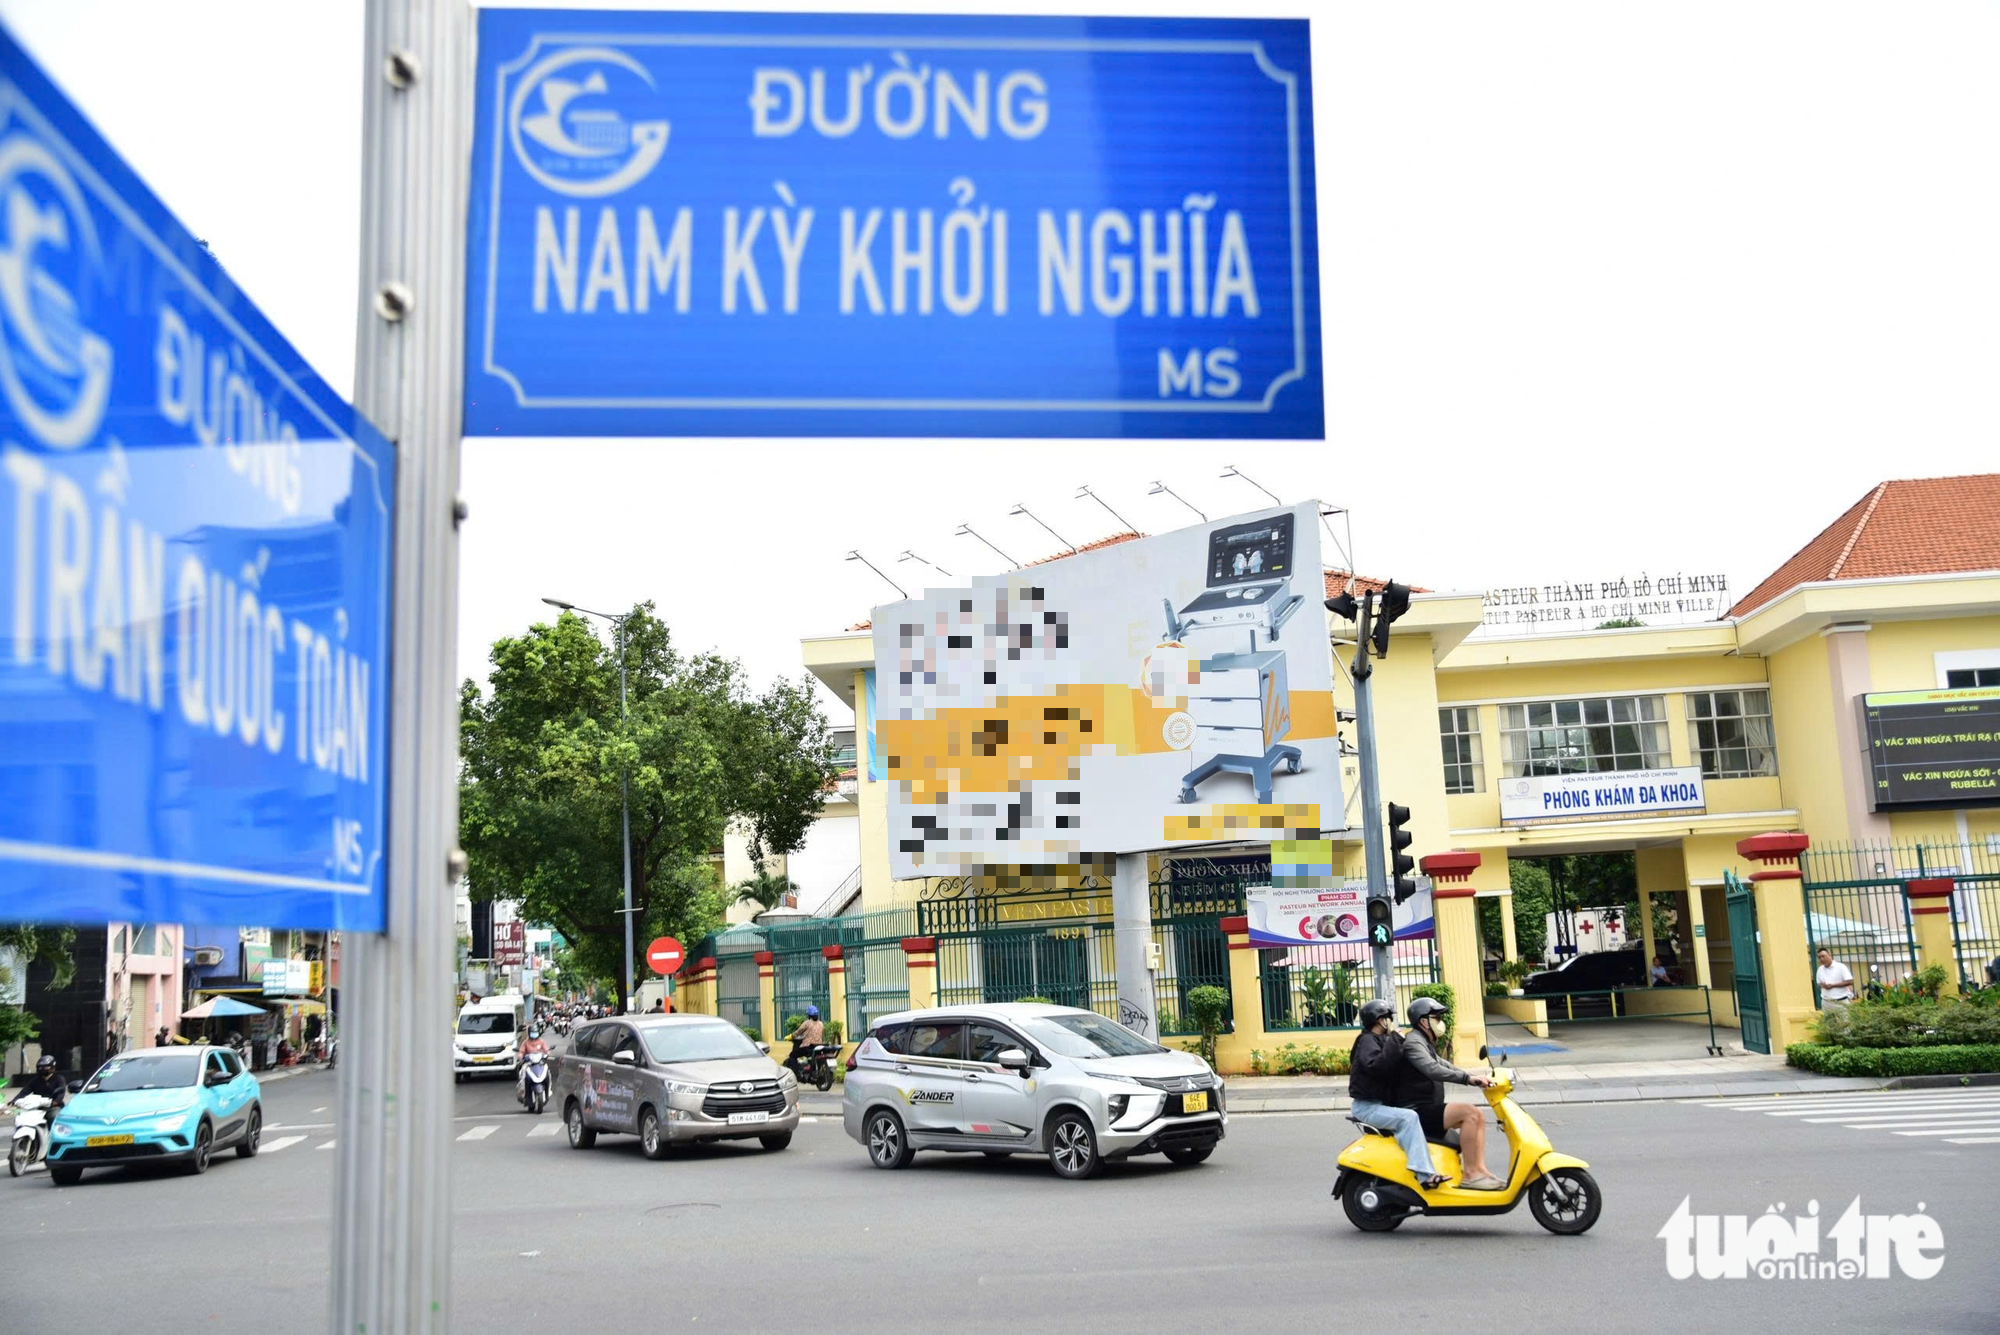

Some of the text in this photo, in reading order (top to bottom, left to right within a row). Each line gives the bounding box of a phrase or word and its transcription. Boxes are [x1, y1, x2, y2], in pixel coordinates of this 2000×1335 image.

[749, 52, 1049, 139] ĐƯỜNG
[533, 178, 1260, 317] NAM KỲ KHỞI NGHĨA
[1158, 348, 1240, 397] MS
[1544, 580, 1594, 603] THÀNH
[1601, 575, 1627, 599] PHỐ
[1633, 571, 1651, 597] HỒ
[1658, 572, 1683, 595] CHÍ
[1688, 575, 1727, 593] MINH
[5, 438, 369, 784] TRẦN QUỐC TOẢN
[1516, 607, 1571, 623] PASTEUR
[1638, 601, 1671, 615] MINH
[1676, 598, 1715, 612] VILLE
[1874, 739, 1880, 747] 9
[1906, 736, 1922, 745] XIN
[1878, 780, 1888, 788] 10
[1924, 771, 1941, 779] XIN
[1951, 779, 1997, 789] RUBELLA
[1543, 783, 1698, 809] PHÒNG KHÁM ĐA KHOA
[1230, 860, 1272, 875] KHÁM
[1308, 900, 1339, 908] NETWORK
